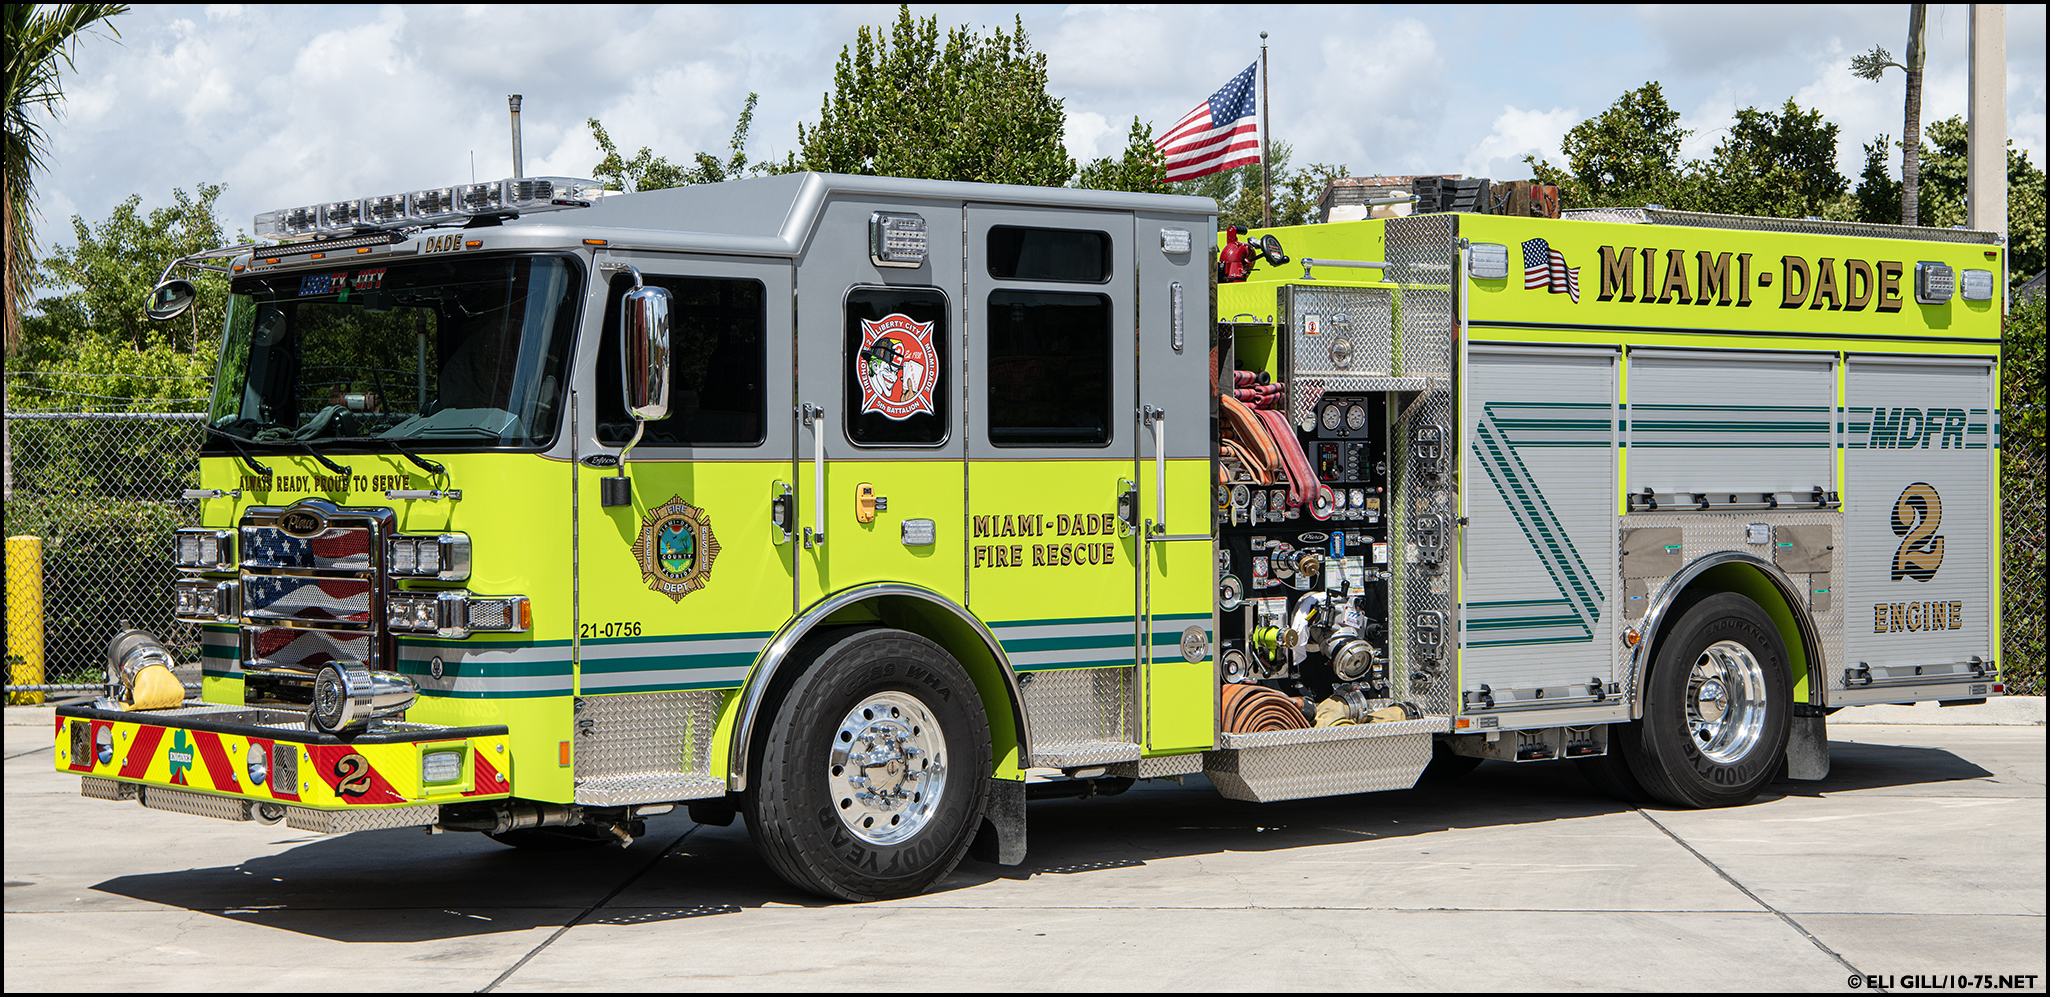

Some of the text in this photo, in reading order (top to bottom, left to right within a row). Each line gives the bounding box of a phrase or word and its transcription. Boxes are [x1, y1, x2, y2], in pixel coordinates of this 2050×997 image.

[425, 234, 463, 253] DADE
[298, 268, 386, 296] LIBERTY CITY
[1596, 245, 1904, 314] MIAMI-DADE
[875, 320, 921, 335] LIBERTY CITY
[924, 342, 935, 393] MIAMI-DADE
[886, 401, 920, 414] BATTALION
[1869, 407, 1967, 449] MDFR
[239, 474, 410, 494] ALWAYS READY, PROUD TO SERVE
[287, 514, 316, 531] Pierce
[666, 505, 687, 515] FIRE
[973, 513, 1115, 538] MIAMI-DADE
[1890, 481, 1945, 583] 2
[973, 543, 1115, 568] FIRE RESCUE
[661, 568, 692, 579] FLORIDA
[580, 621, 642, 638] 21-0756
[1873, 600, 1963, 634] ENGINE
[1704, 619, 1772, 653] ENDURANCE
[905, 664, 952, 703] WHA
[334, 753, 371, 797] 2
[817, 804, 962, 875] GOODYEAR
